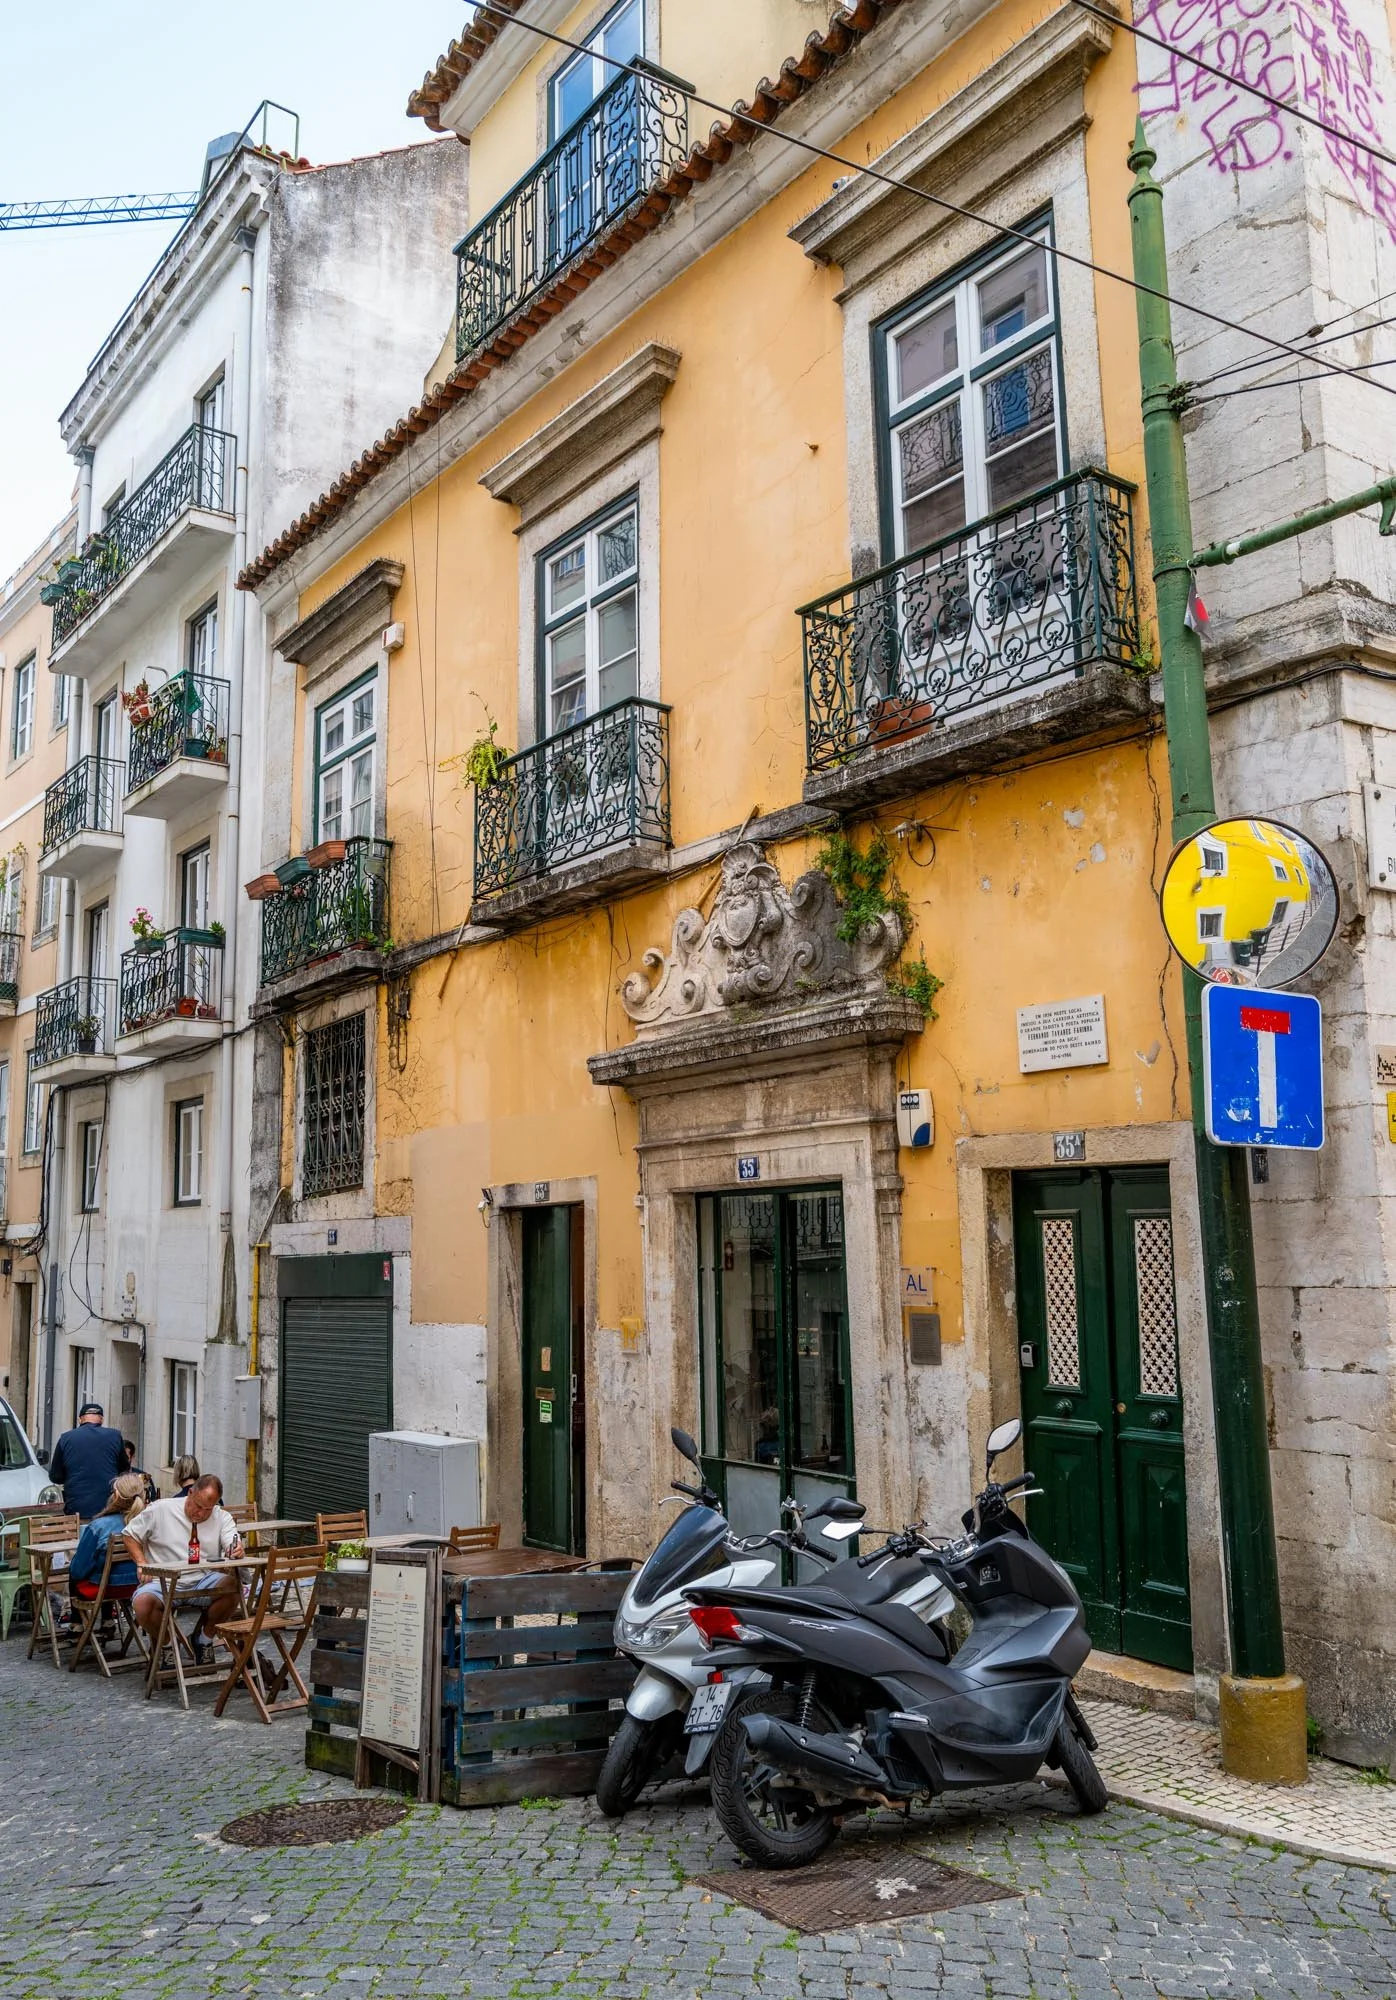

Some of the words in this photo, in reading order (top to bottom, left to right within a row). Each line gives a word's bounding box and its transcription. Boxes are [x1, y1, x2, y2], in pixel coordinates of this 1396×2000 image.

[1028, 1032, 1049, 1041] FERNANDO
[1052, 1029, 1071, 1037] TAVARES
[1074, 1026, 1093, 1034] FARINHA
[741, 1158, 755, 1178] 35
[906, 1273, 928, 1292] AL
[788, 1618, 840, 1633] PCX
[705, 1686, 718, 1703] 14
